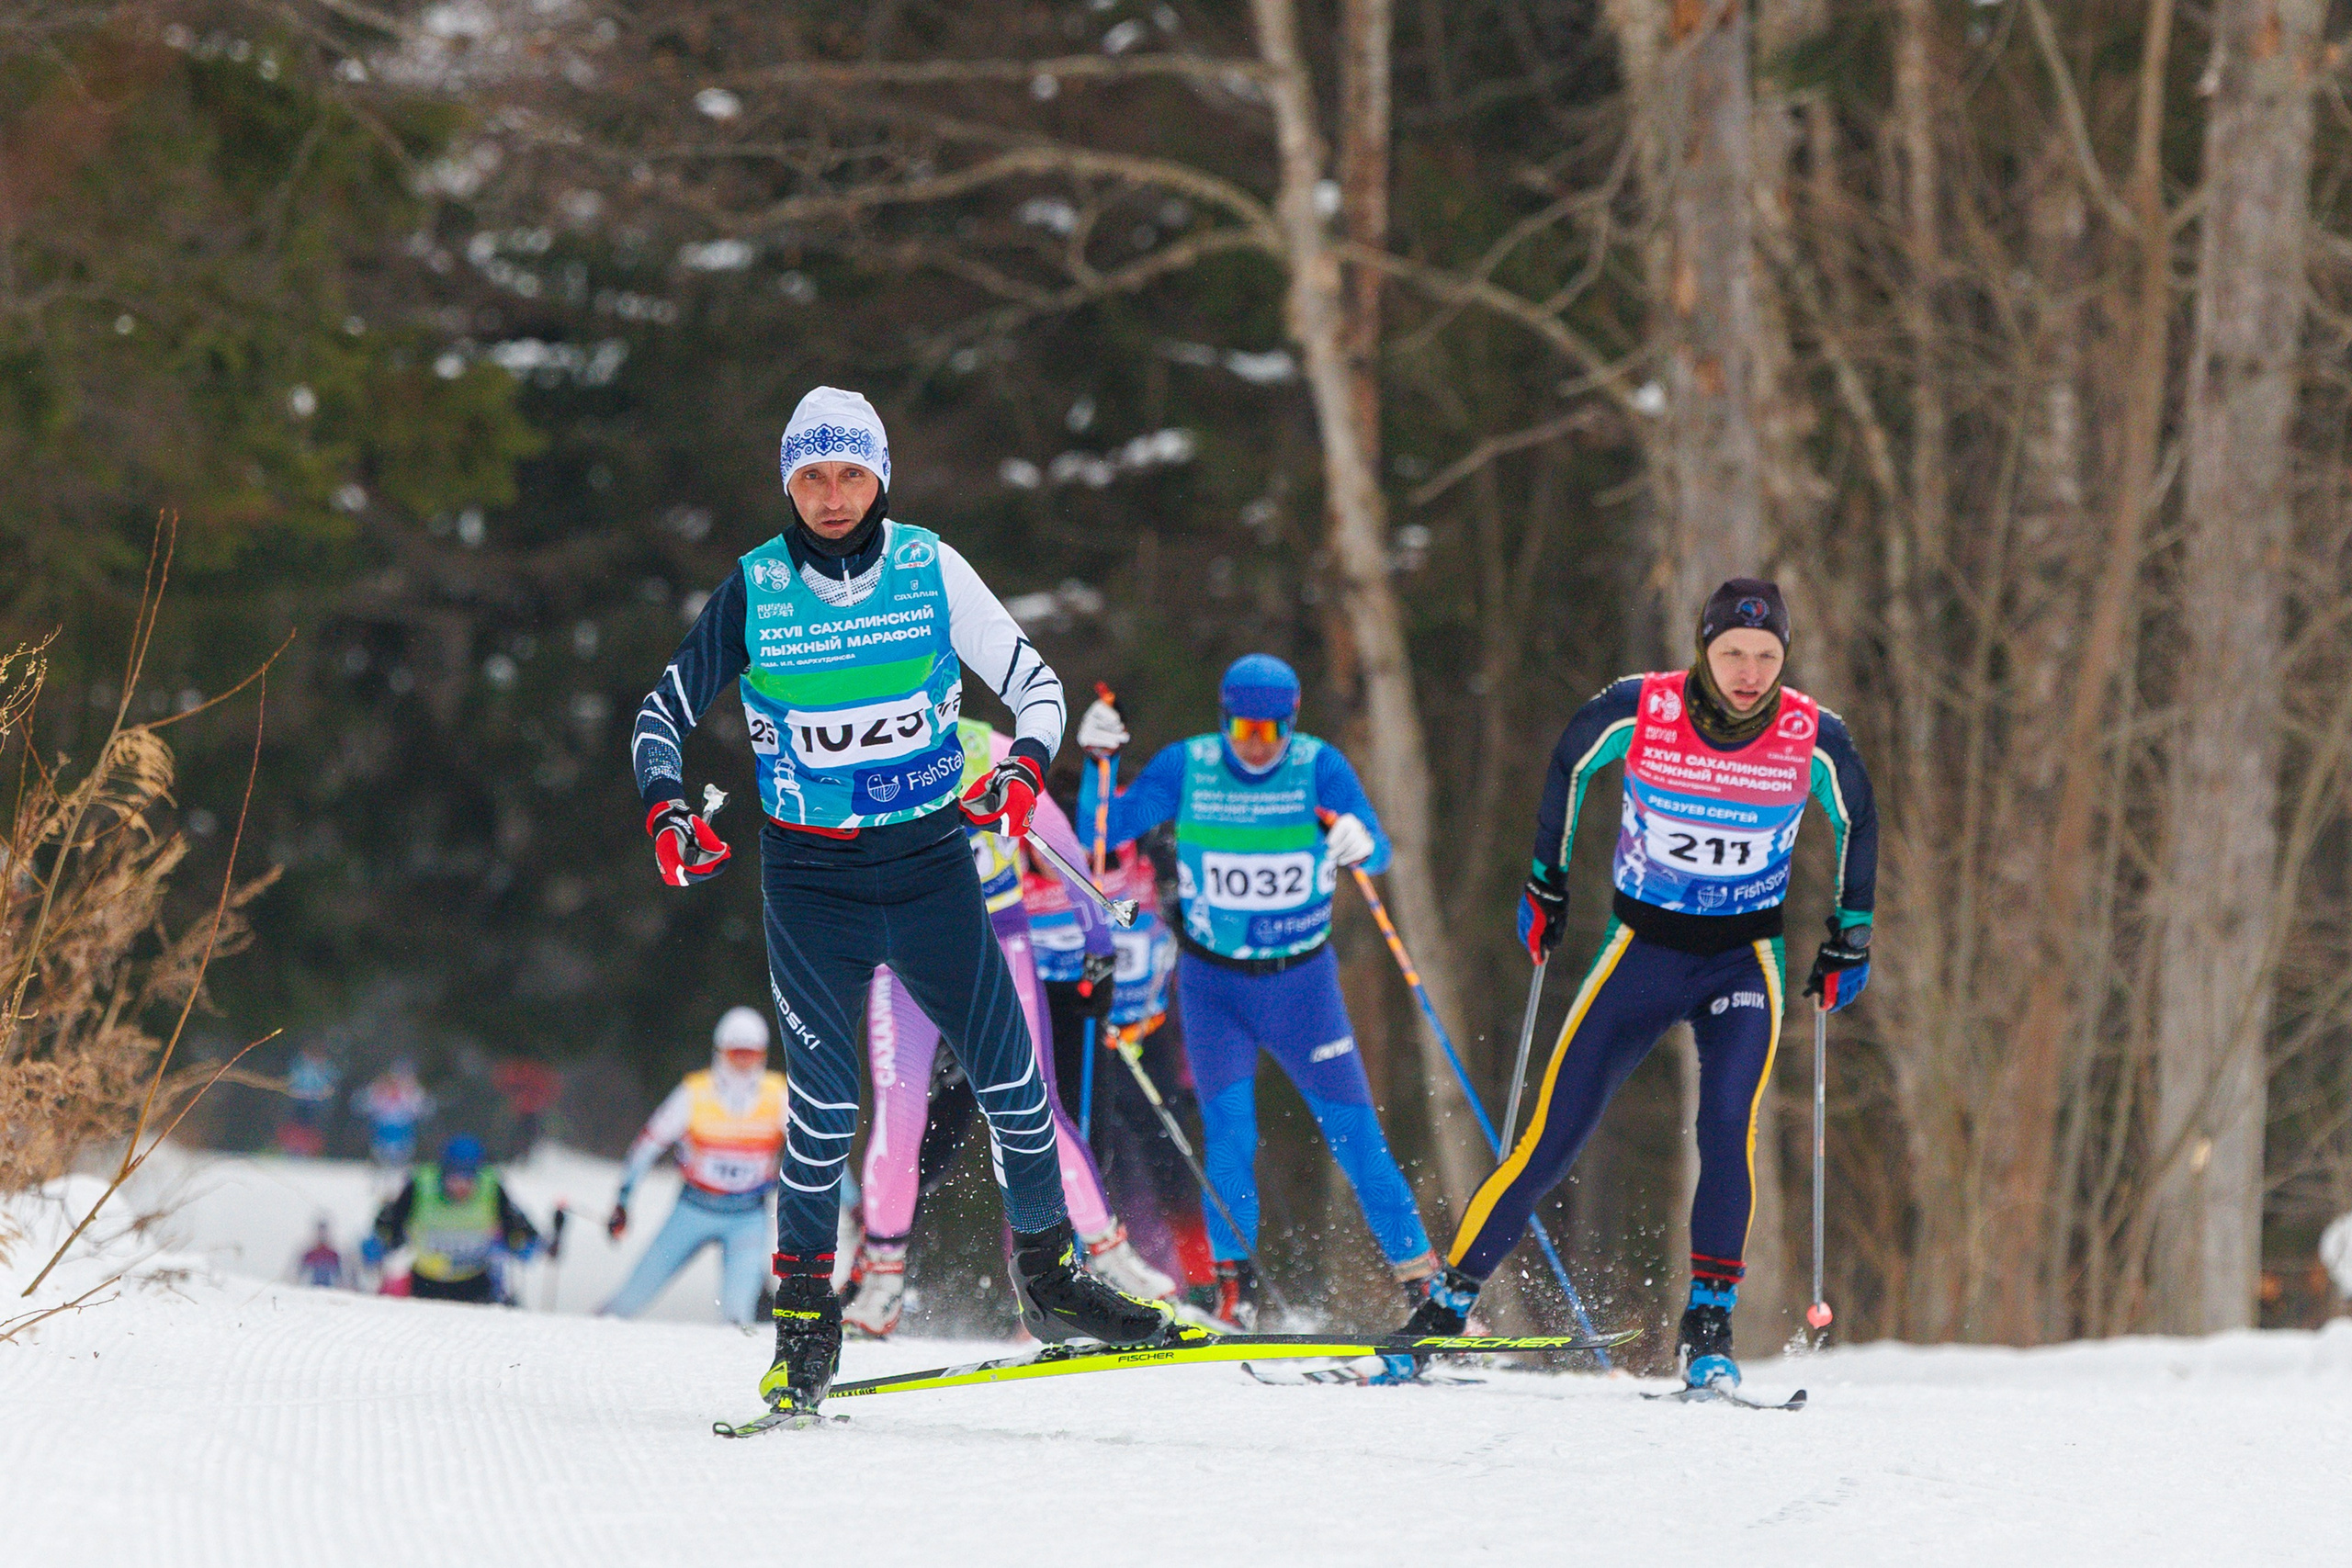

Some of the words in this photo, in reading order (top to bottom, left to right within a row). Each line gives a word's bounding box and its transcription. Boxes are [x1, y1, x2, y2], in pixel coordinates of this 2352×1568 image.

[759, 626, 803, 641] XXVII
[808, 604, 934, 636] САХАЛИНСКИЙ
[760, 636, 842, 657] ЛЫЖНЫЙ
[847, 625, 932, 649] МАРАФОН
[801, 708, 923, 753] 1025
[1642, 746, 1681, 763] XXVII
[1685, 754, 1797, 780] САХАЛИНСКИЙ
[1715, 773, 1792, 793] МАРАФОН
[1648, 795, 1706, 816] РЕБЗУЕВ
[1707, 806, 1758, 824] СЕРГЕЙ
[1211, 866, 1303, 897] 1032
[770, 971, 820, 1051] RDSKI
[1731, 991, 1765, 1010] SWIX
[1118, 1351, 1174, 1363] FISCHER
[1412, 1337, 1572, 1348] FISCHER
